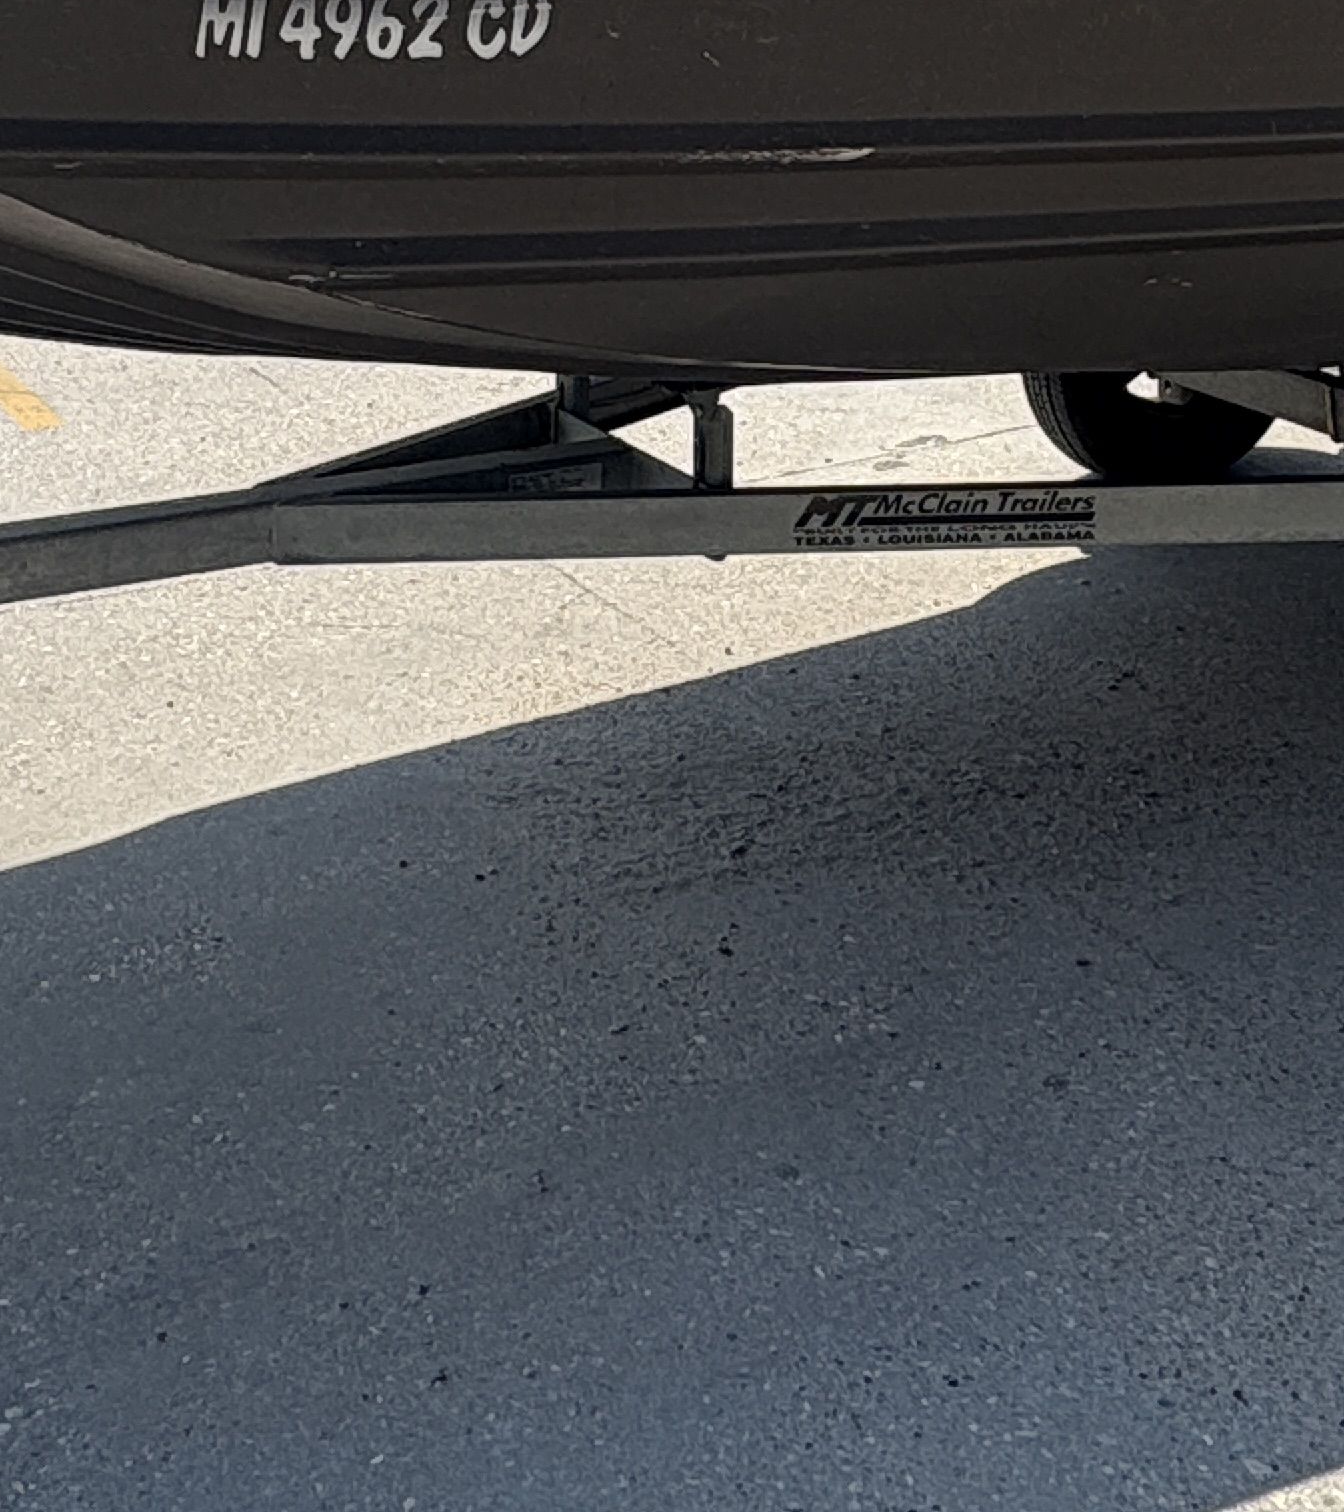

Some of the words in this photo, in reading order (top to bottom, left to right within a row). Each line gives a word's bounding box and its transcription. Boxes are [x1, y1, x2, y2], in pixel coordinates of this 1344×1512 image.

[997, 490, 1097, 513] Trailers
[794, 535, 856, 547] TEXAS
[877, 532, 983, 546] LOUISIANA
[1004, 529, 1096, 543] ALABAMA
